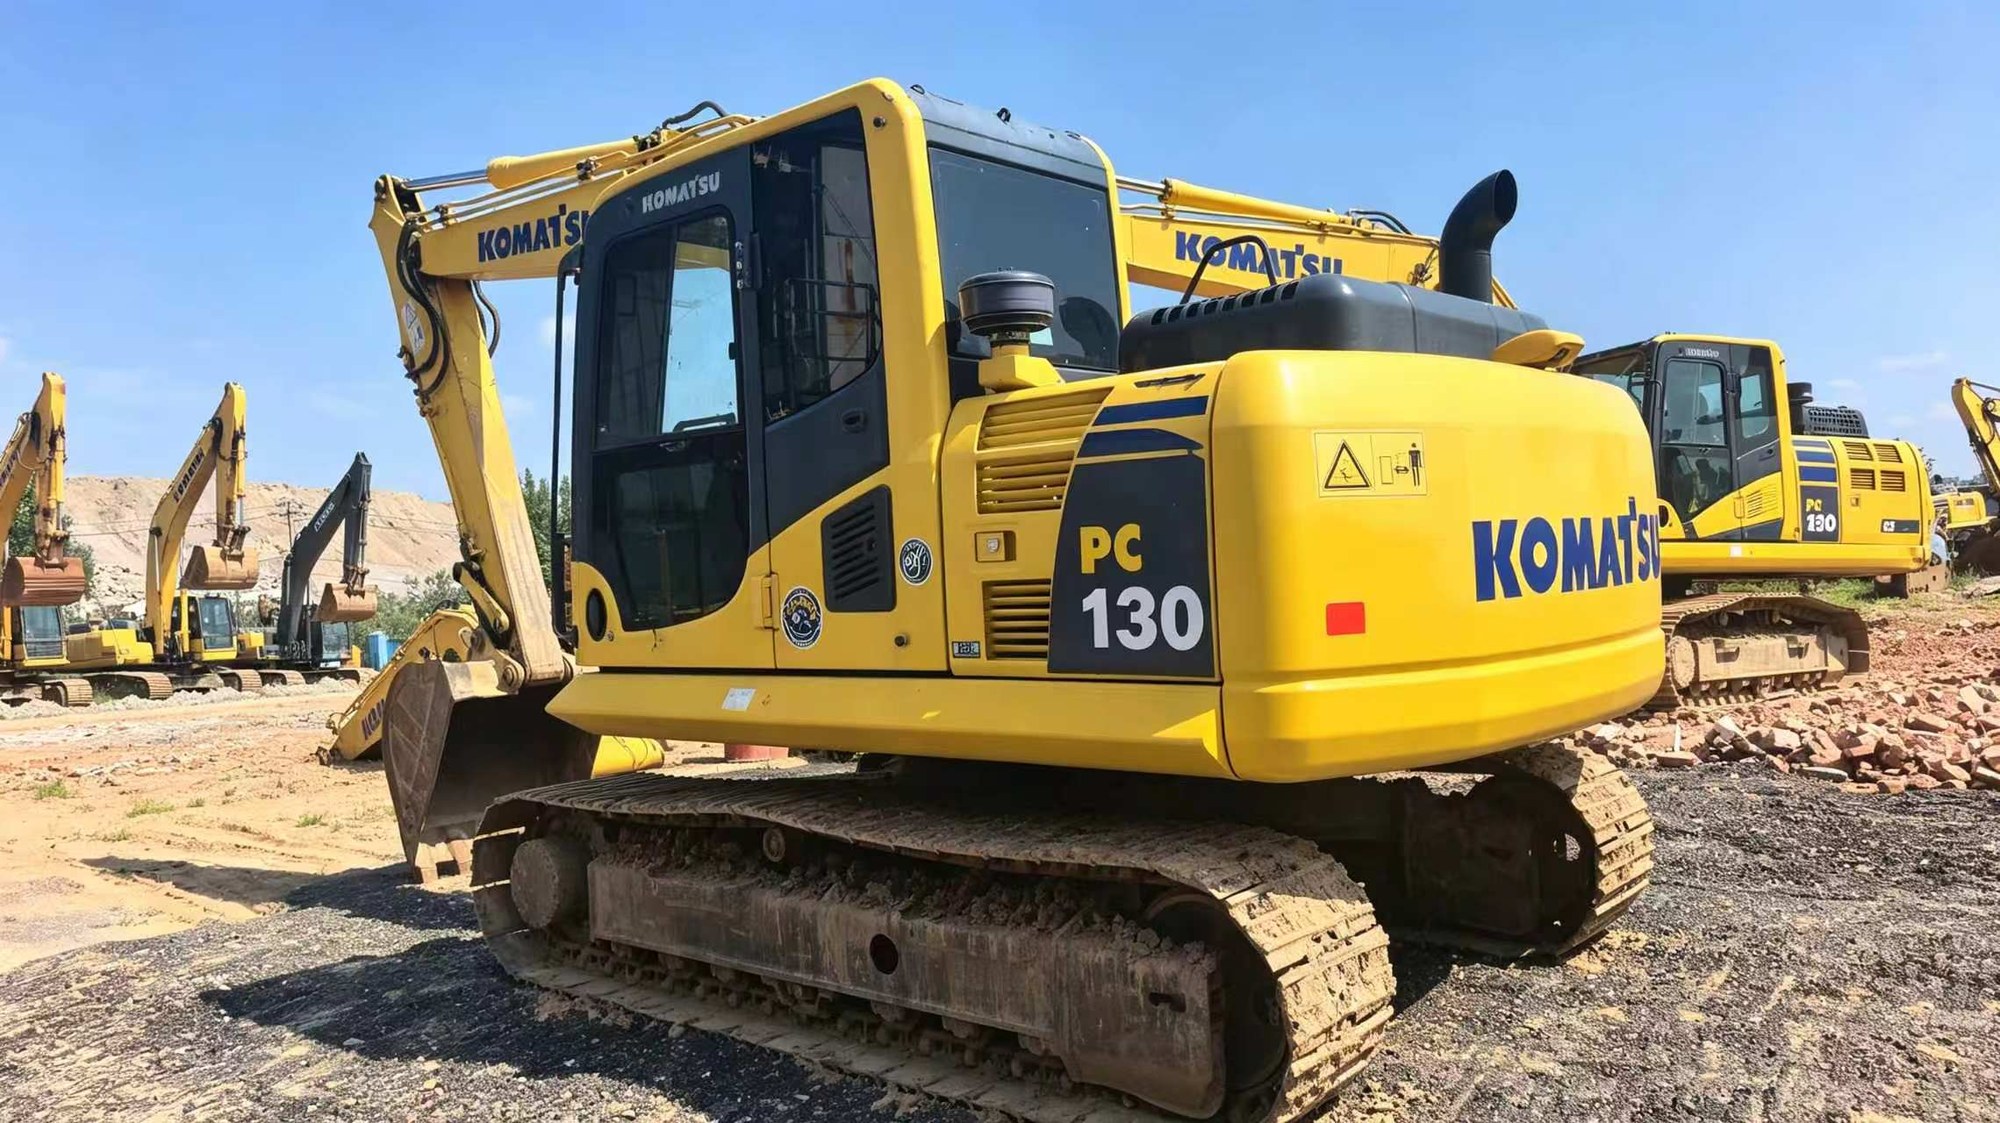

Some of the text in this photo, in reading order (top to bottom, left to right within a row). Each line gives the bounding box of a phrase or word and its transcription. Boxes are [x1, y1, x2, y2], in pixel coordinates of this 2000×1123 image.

[642, 171, 720, 214] KOMATSU
[1080, 523, 1143, 574] PC
[1472, 497, 1661, 602] KOMATSU
[1082, 585, 1204, 651] 130
